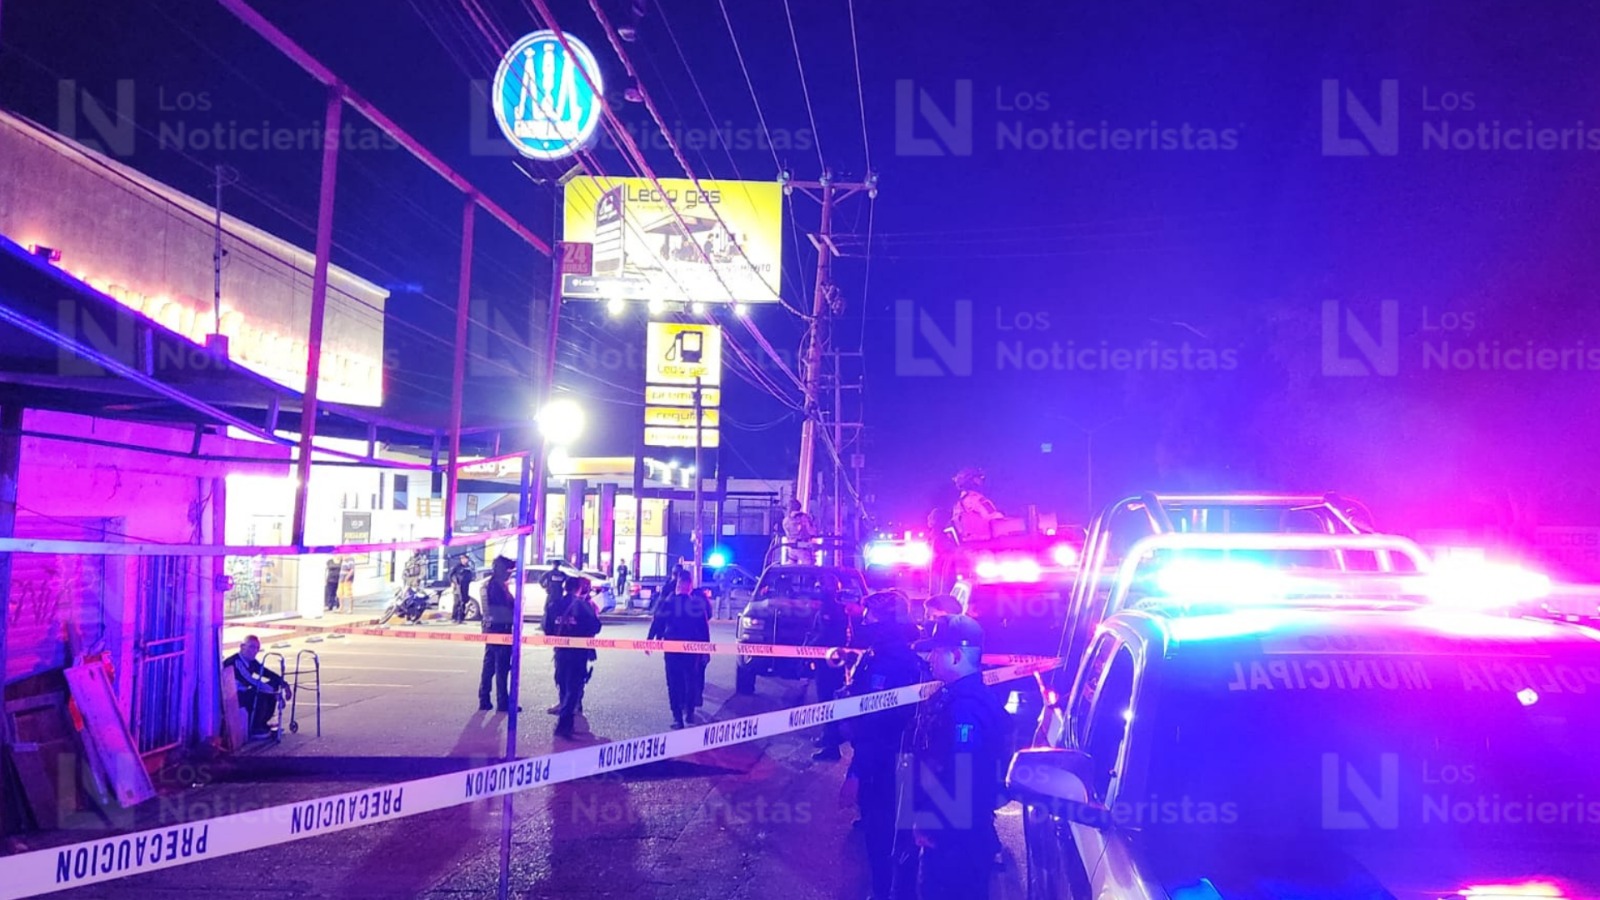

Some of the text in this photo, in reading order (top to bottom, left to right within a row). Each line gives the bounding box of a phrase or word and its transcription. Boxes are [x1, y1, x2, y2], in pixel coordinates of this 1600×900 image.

[685, 190, 721, 208] gas
[563, 244, 587, 263] 24
[789, 703, 834, 728] PRECAUCION
[703, 718, 759, 747] PRECAUCION
[599, 733, 666, 768] PRECAUCION
[465, 759, 550, 796] PRECAUCION
[291, 788, 403, 834] PRECAUCION
[56, 825, 208, 884] PRECAUCION
